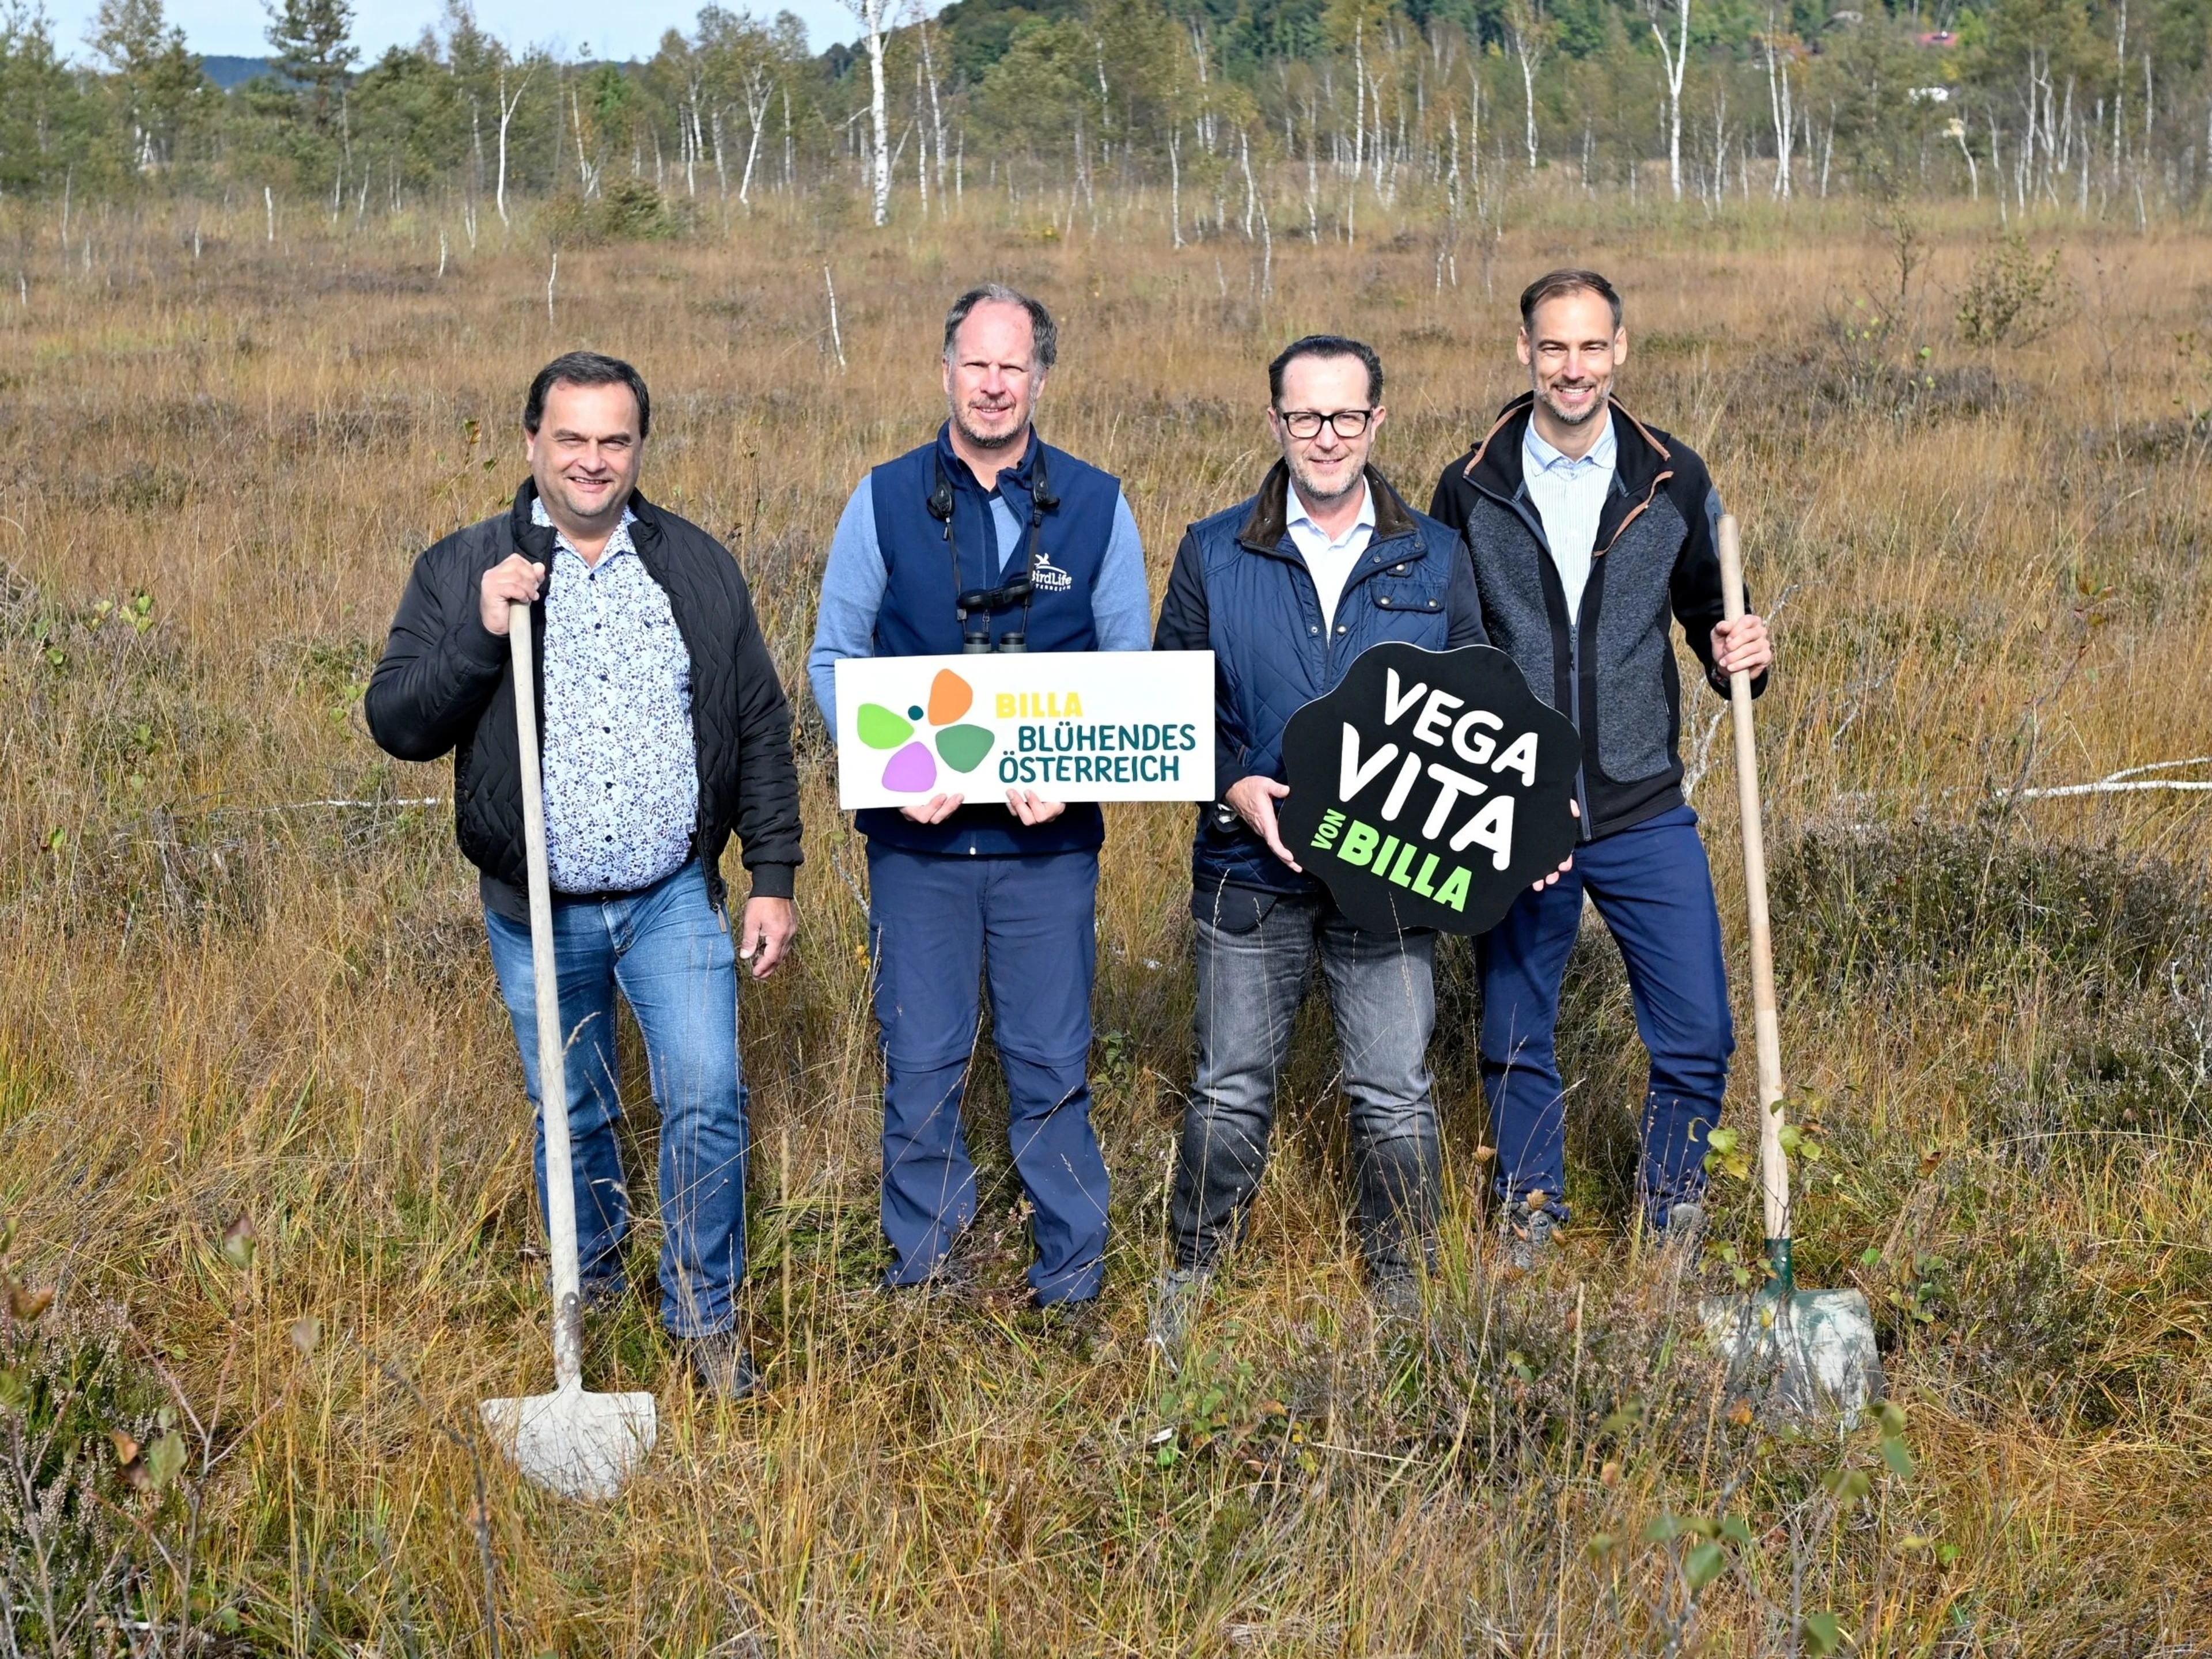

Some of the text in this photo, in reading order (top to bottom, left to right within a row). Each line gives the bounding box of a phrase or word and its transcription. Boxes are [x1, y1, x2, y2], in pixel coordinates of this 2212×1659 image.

[996, 692, 1084, 719] BILLA
[1018, 721, 1196, 752] BLÜHENDES
[1385, 668, 1538, 787] VEGA
[999, 751, 1180, 783] ÖSTERREICH
[1339, 722, 1515, 871] VITA
[1310, 808, 1472, 912] VON BILLA
